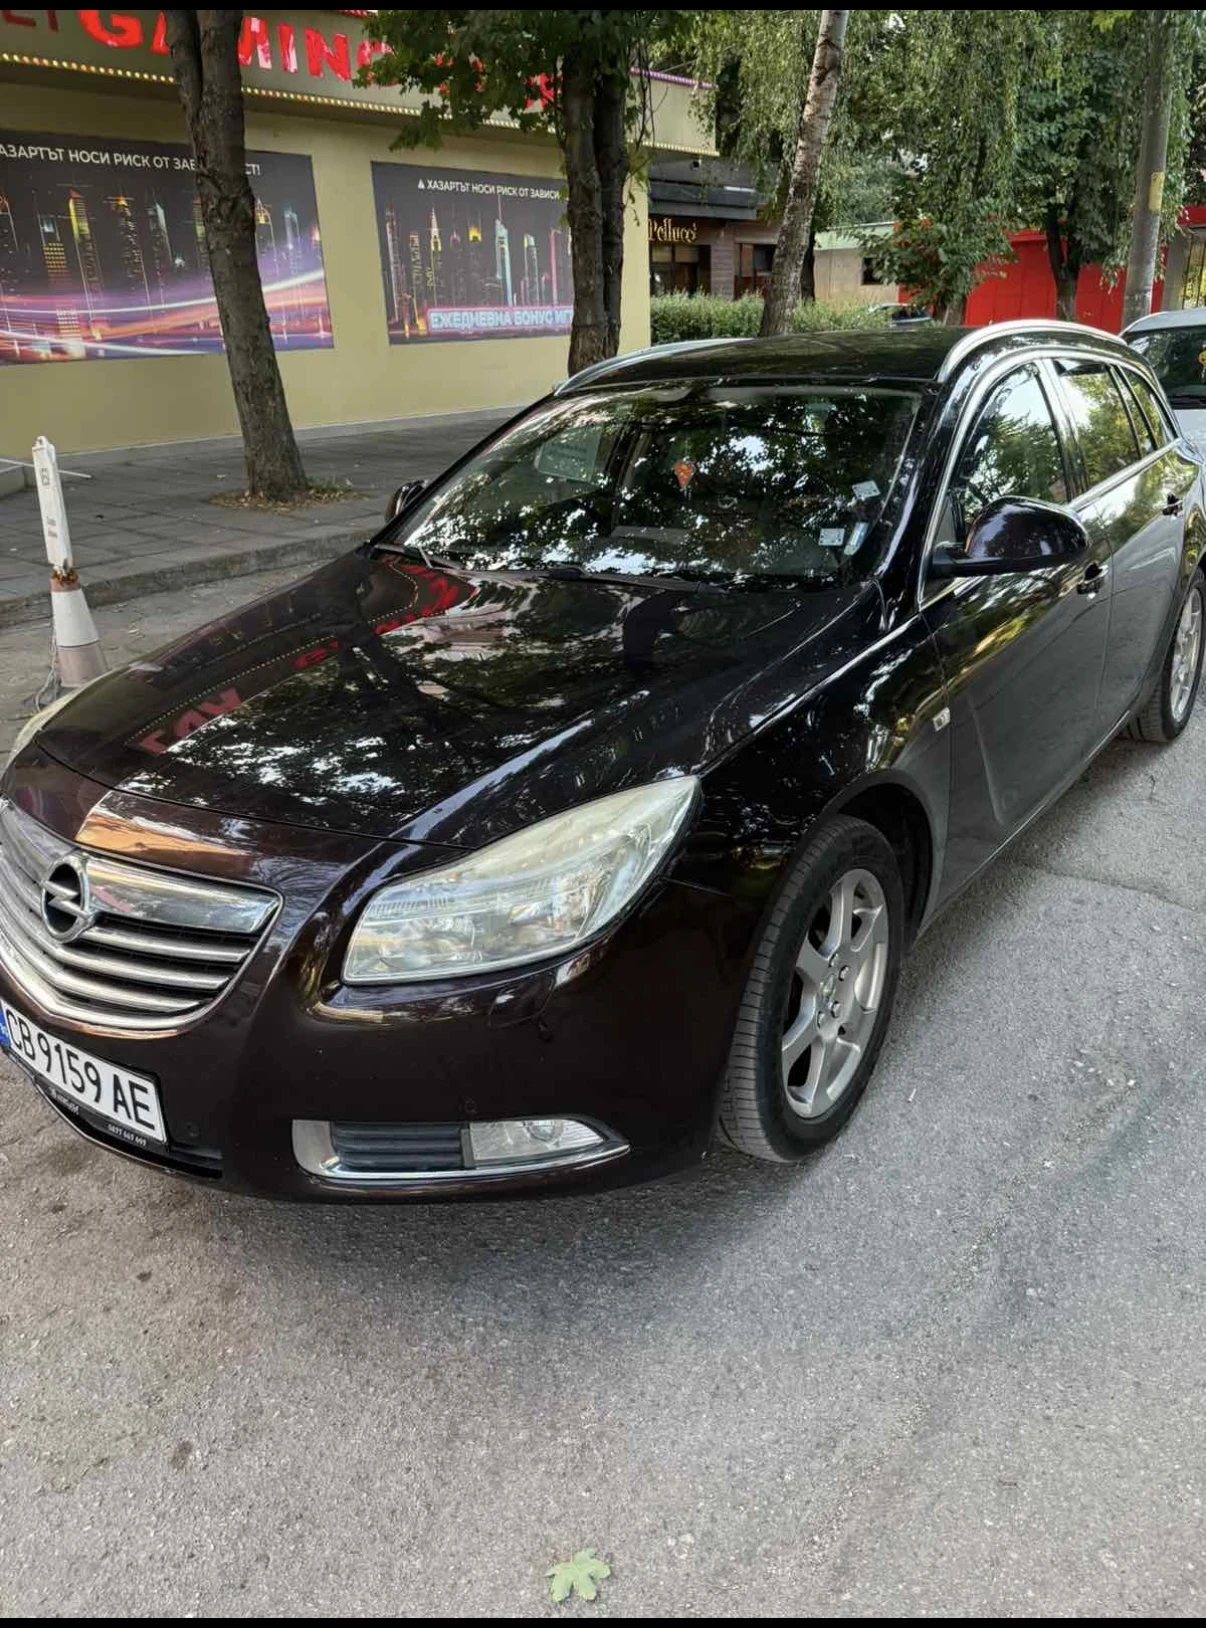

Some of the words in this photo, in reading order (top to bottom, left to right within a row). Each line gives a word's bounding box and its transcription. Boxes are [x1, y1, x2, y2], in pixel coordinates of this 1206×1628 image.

[69, 147, 111, 165] НОСИ
[114, 152, 151, 168] РИСК
[153, 156, 170, 169] ОТ
[427, 179, 470, 193] ХАЗАРТЪТ
[472, 183, 495, 195] НОСИ
[497, 185, 517, 197] РИСК
[519, 187, 529, 197] ОТ
[430, 311, 513, 329] ЕЖЕДНЕВНА
[514, 309, 553, 326] БОНУС
